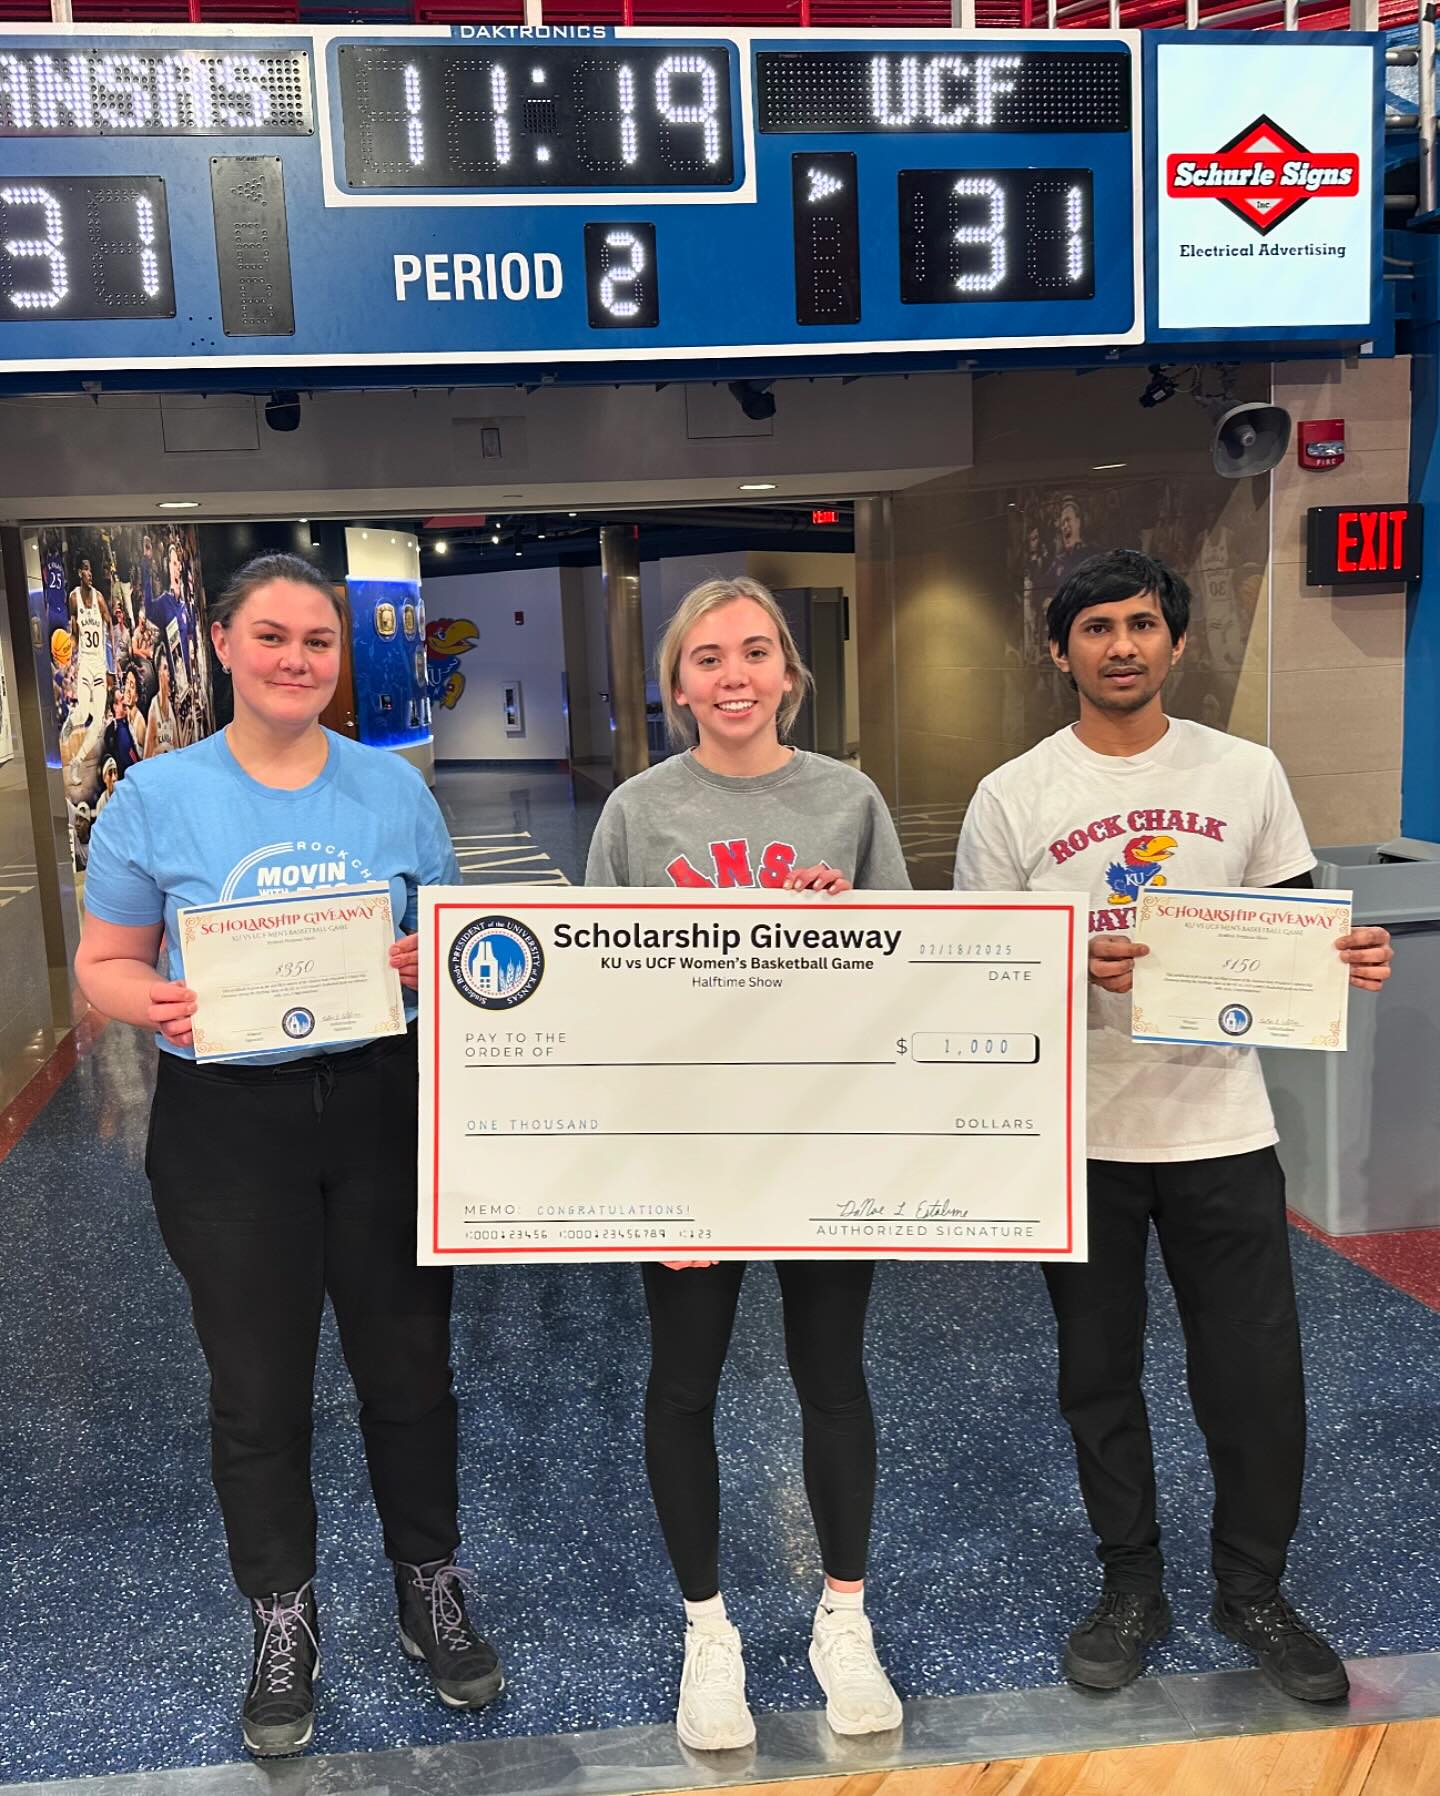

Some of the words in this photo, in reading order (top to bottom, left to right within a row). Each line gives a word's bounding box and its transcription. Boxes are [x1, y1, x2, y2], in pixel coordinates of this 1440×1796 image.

[459, 25, 606, 39] DAKTRONICS
[870, 56, 1022, 128] UCF
[404, 55, 721, 165] 11:19
[1174, 162, 1275, 186] Schurle
[1280, 161, 1353, 191] Signs
[953, 178, 1084, 292] 31
[0, 186, 160, 308] 31
[1179, 244, 1254, 257] Electrical
[1258, 243, 1347, 258] Advertising
[393, 252, 564, 301] PERIOD
[600, 231, 645, 317] 2
[1337, 510, 1408, 572] EXIT
[49, 571, 62, 589] 25
[84, 631, 100, 648] 30
[1048, 813, 1127, 865] ROCK
[1126, 808, 1228, 842] CHALK
[296, 841, 348, 860] ROCK
[256, 860, 346, 887] MOVIN
[1125, 872, 1145, 886] KU
[201, 912, 301, 935] SCHOLARSHIP
[303, 906, 376, 924] GIVEAWAY
[1156, 905, 1257, 923] SCHOLARSHIP
[1259, 910, 1336, 929] GIVEAWAY
[452, 921, 485, 962] PRESIDENT
[506, 921, 541, 967] UNIVERSITY
[553, 922, 741, 956] Scholarship
[750, 923, 902, 956] Giveaway
[274, 959, 315, 977] $350
[600, 957, 622, 969] KU
[626, 960, 642, 969] vs
[646, 957, 676, 969] UCF
[679, 957, 747, 970] Women's
[751, 957, 828, 970] Basketball
[831, 957, 875, 970] Game
[1221, 957, 1261, 974] $150
[692, 976, 746, 988] Halftime
[748, 976, 783, 988] Show
[988, 970, 1032, 981] DATE
[507, 977, 537, 1004] KANSAS
[465, 1032, 497, 1043] PAY
[506, 1032, 527, 1043] TO
[535, 1032, 567, 1043] THE
[895, 1037, 908, 1056] $
[944, 1039, 1008, 1056] 1,000
[465, 1047, 524, 1057] ORDER
[532, 1047, 554, 1057] OF
[467, 1119, 499, 1131] ONE
[509, 1119, 599, 1130] THOUSAND
[955, 1119, 1034, 1130] DOLLARS
[464, 1205, 520, 1216] MEMO:
[536, 1205, 691, 1216] CONGRATULATIONS!
[816, 1225, 928, 1236] AUTHORIZED
[936, 1226, 1034, 1237] SIGNATURE
